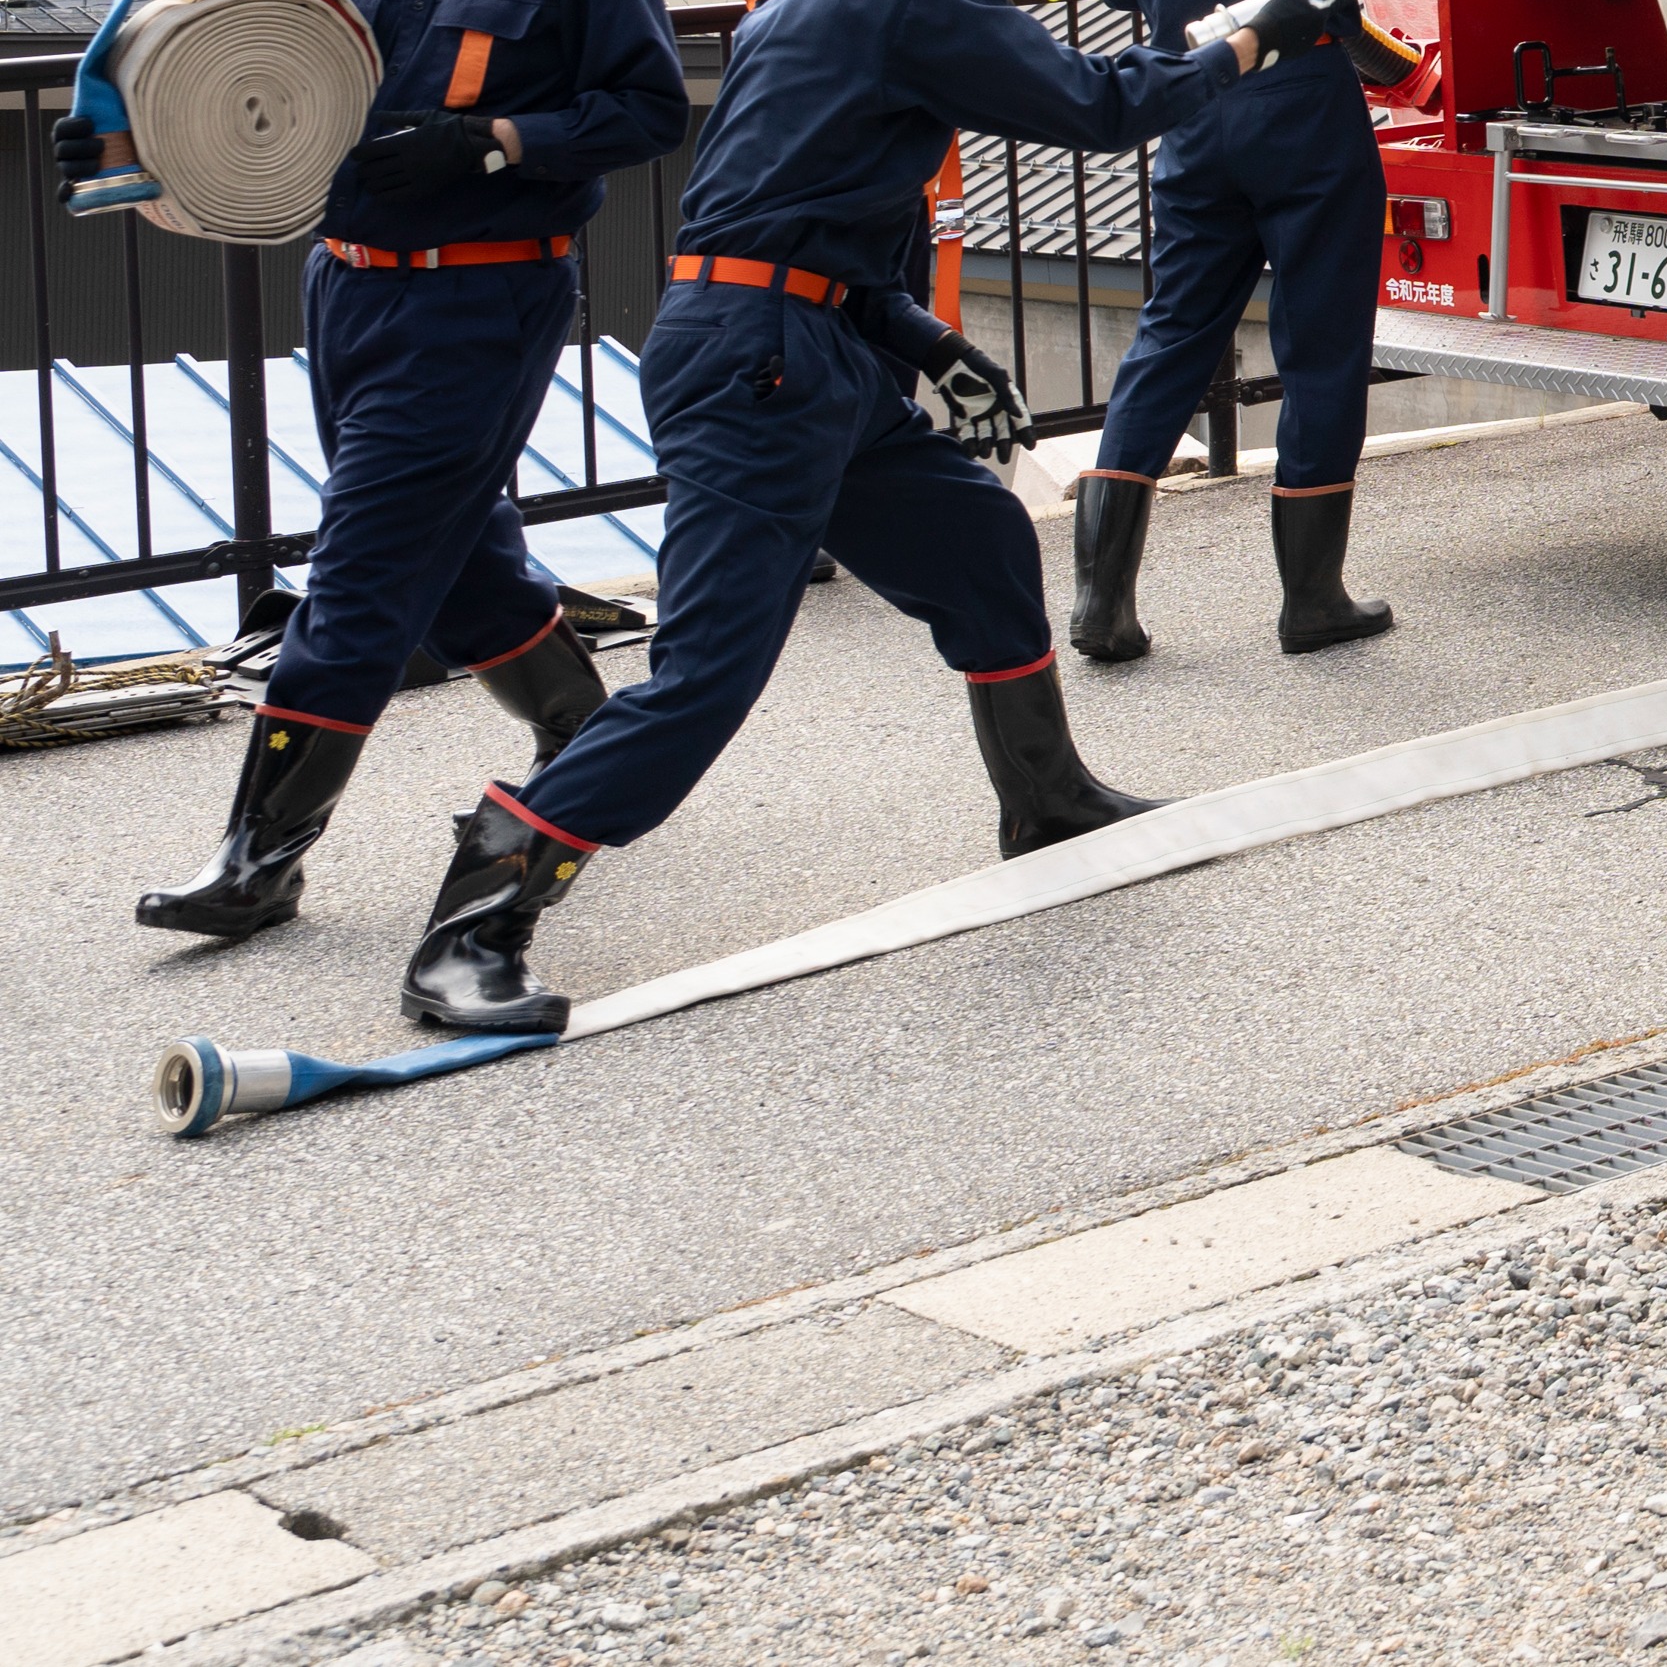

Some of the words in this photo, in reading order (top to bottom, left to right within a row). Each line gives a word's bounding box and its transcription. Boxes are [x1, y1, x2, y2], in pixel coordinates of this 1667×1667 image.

[1589, 258, 1599, 281] さ
[1385, 277, 1455, 307] 令和元年度
